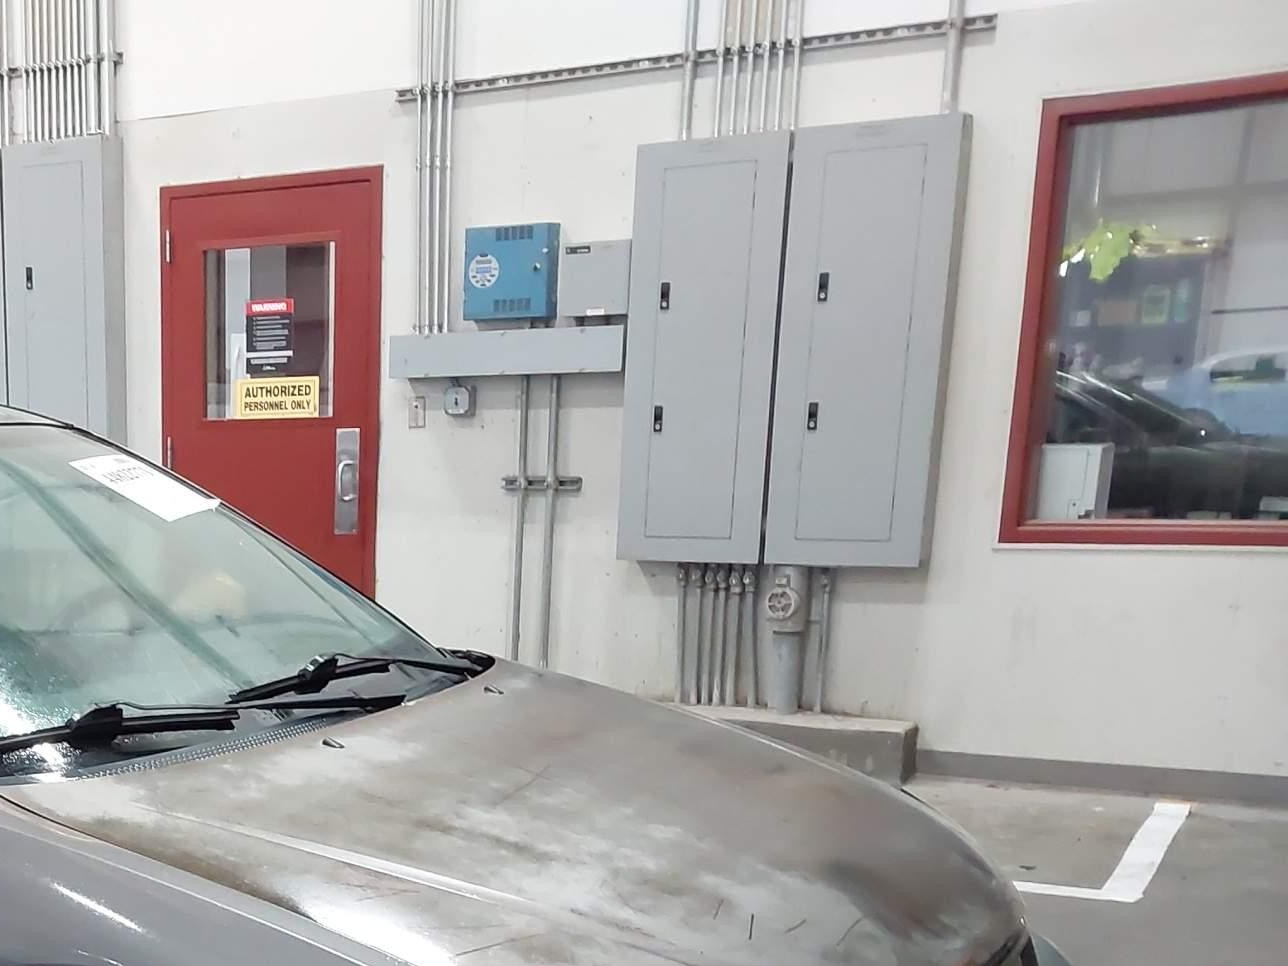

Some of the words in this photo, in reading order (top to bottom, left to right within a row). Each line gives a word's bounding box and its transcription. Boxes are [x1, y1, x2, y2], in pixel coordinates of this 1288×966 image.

[244, 384, 312, 398] AUTHORIZED
[244, 400, 288, 411] PERSONNEL
[291, 399, 311, 410] ONLY
